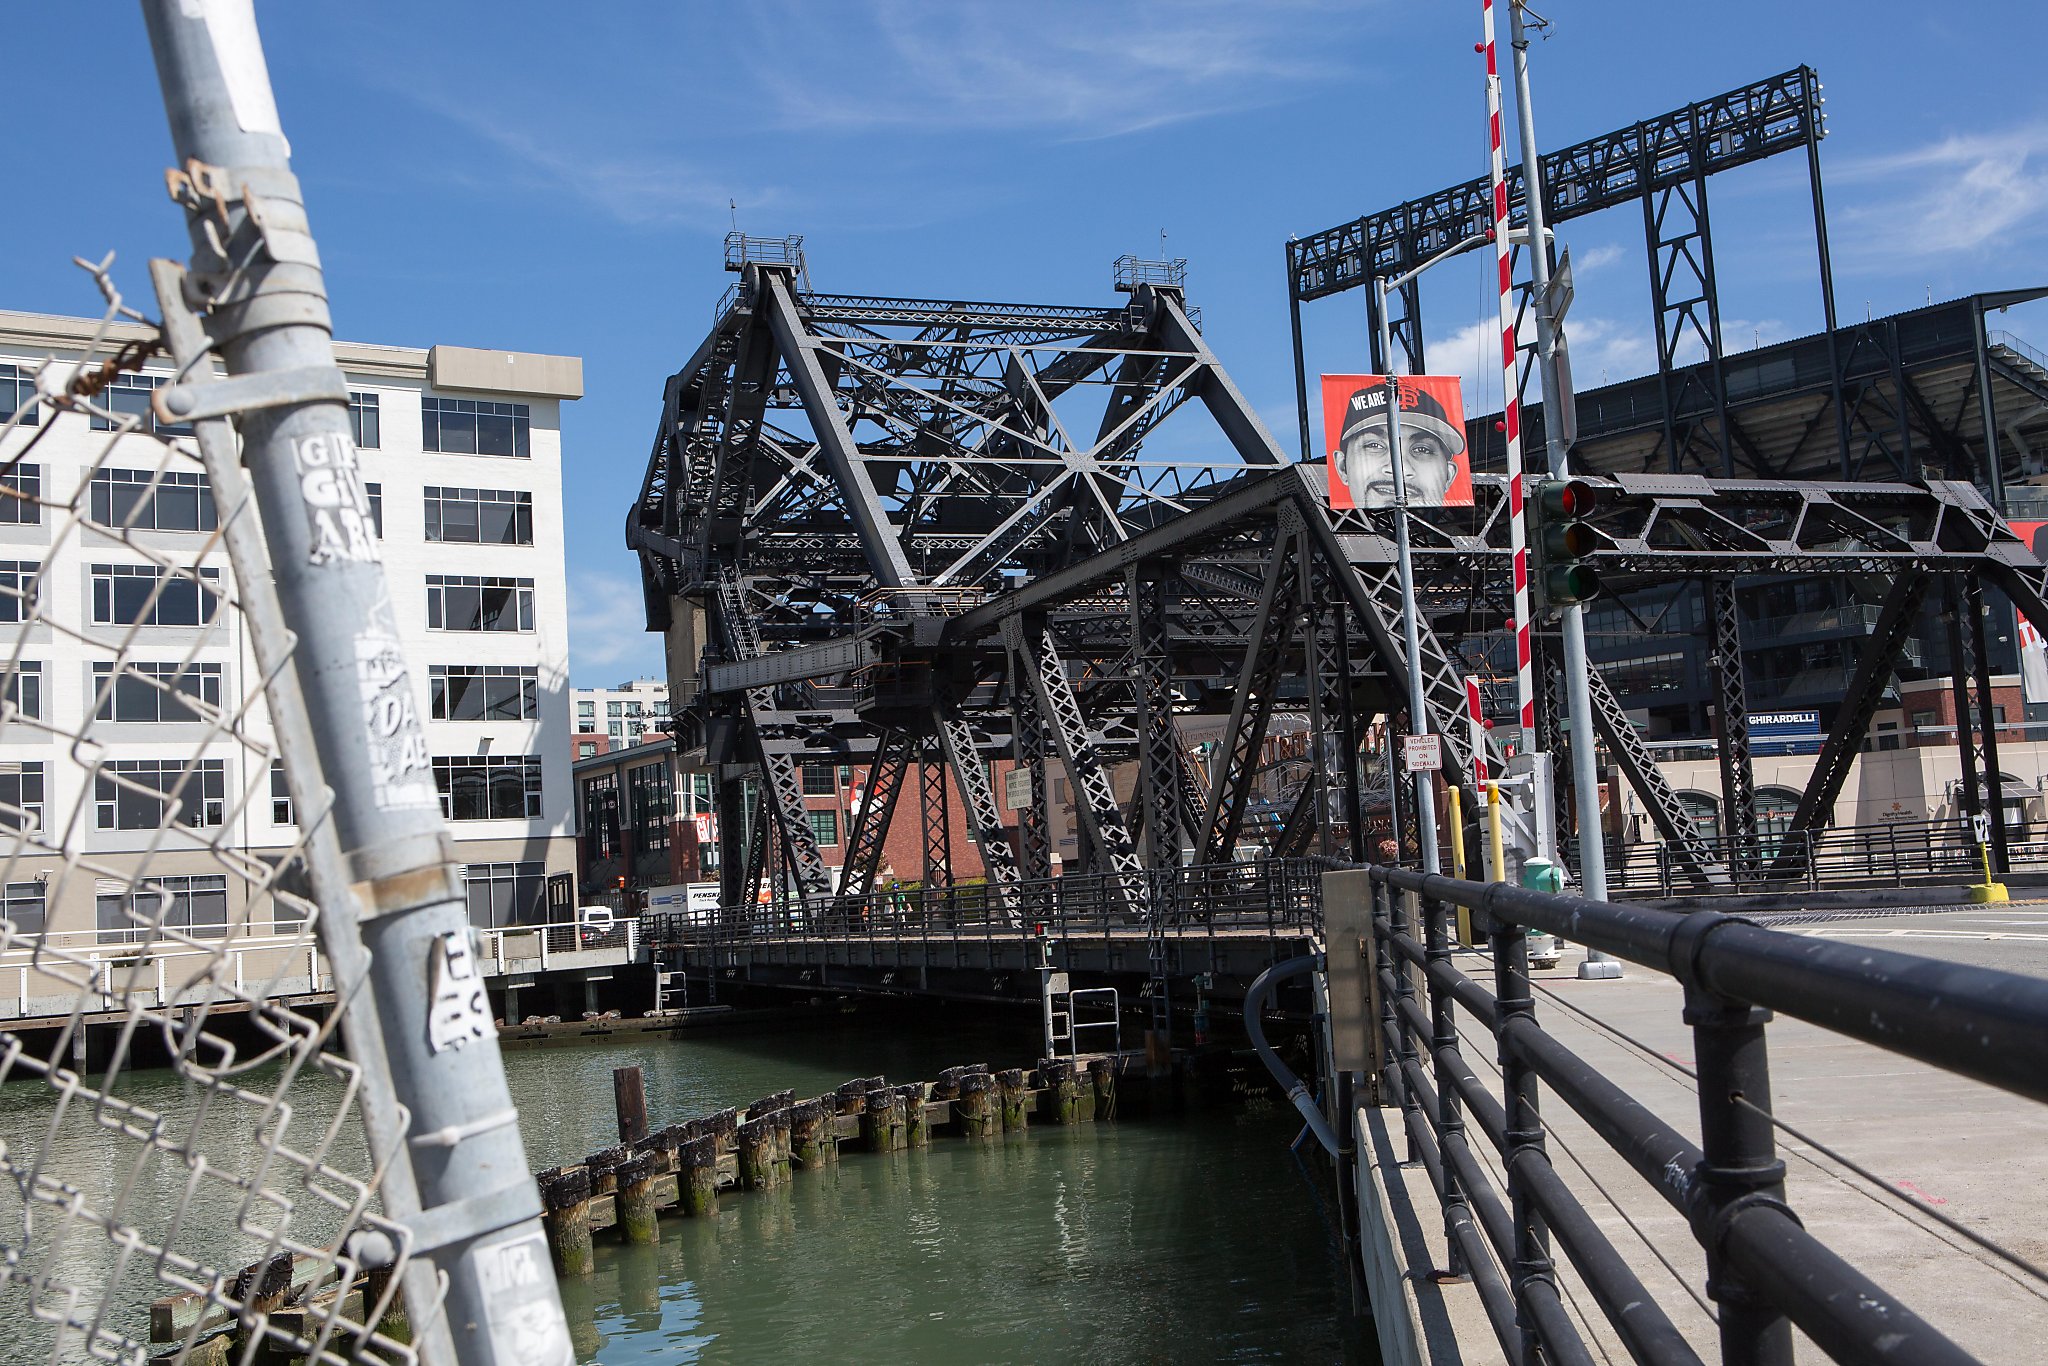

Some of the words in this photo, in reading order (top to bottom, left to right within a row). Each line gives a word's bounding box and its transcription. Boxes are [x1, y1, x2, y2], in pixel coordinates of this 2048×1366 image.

[1350, 394, 1369, 411] WE
[1367, 391, 1387, 408] ARE
[1748, 713, 1815, 725] GHIRARDELLI
[1185, 729, 1221, 741] Francisco
[1410, 737, 1434, 745] VEHICLES
[1408, 744, 1437, 752] PROHIBITED
